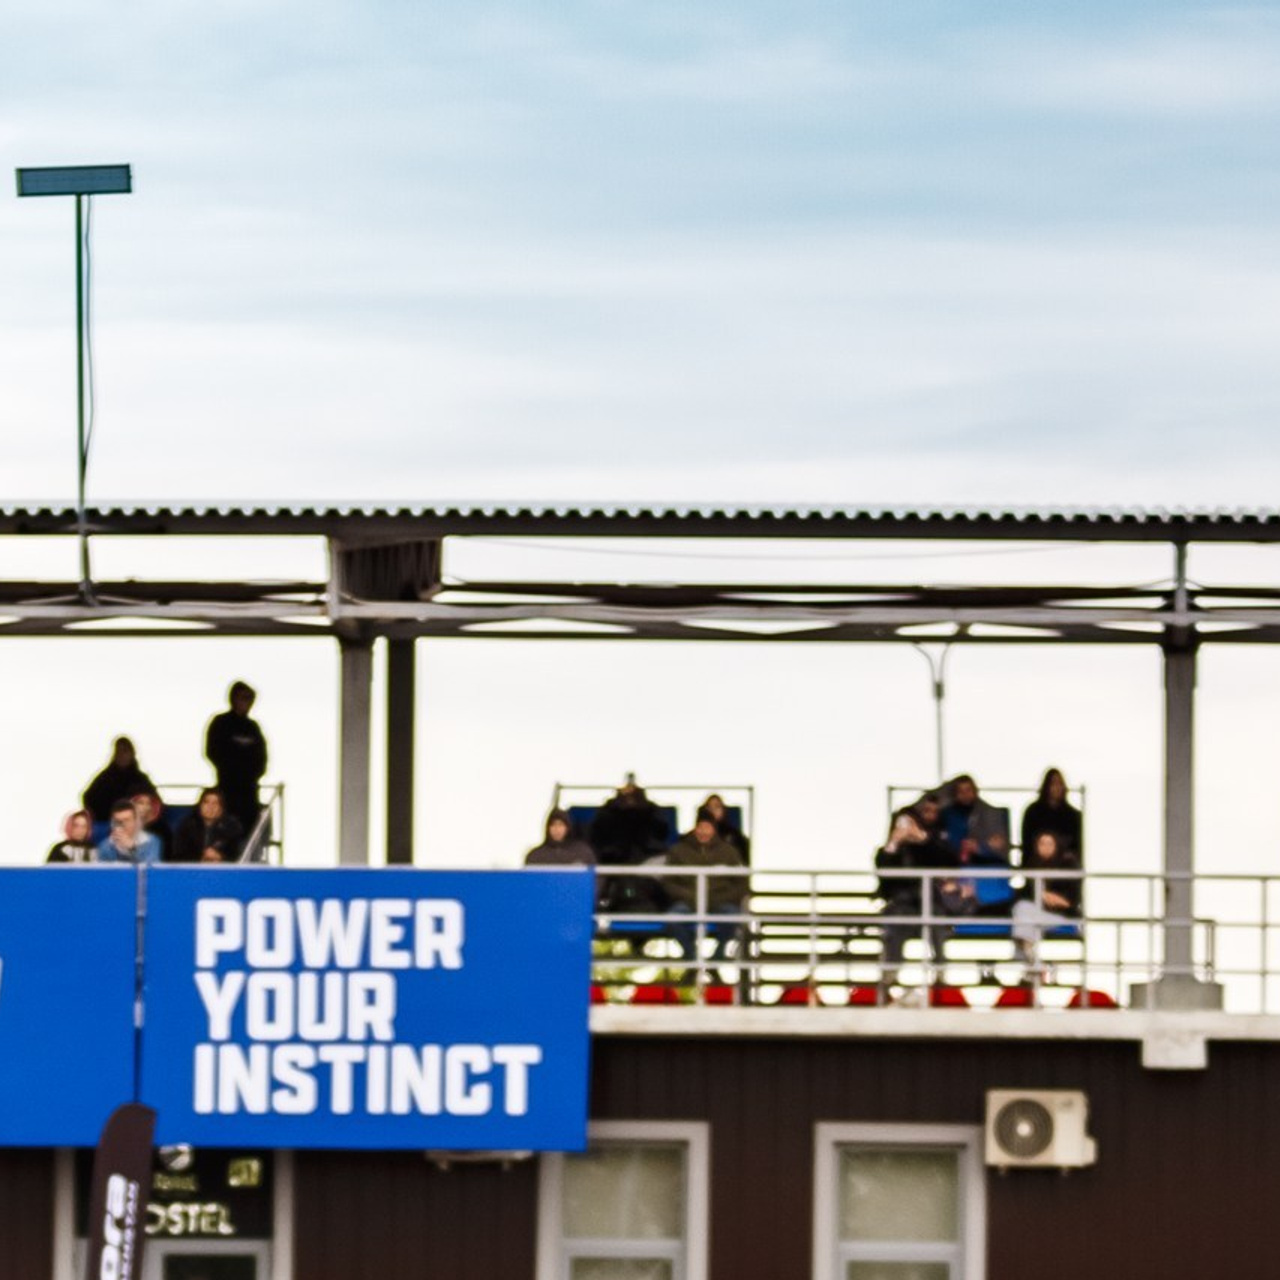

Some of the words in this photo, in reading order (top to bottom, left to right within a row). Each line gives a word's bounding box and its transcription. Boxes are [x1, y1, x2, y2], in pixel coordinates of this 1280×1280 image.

[195, 898, 464, 969] POWER
[194, 971, 396, 1041] YOUR
[194, 1043, 542, 1116] INSTINCT
